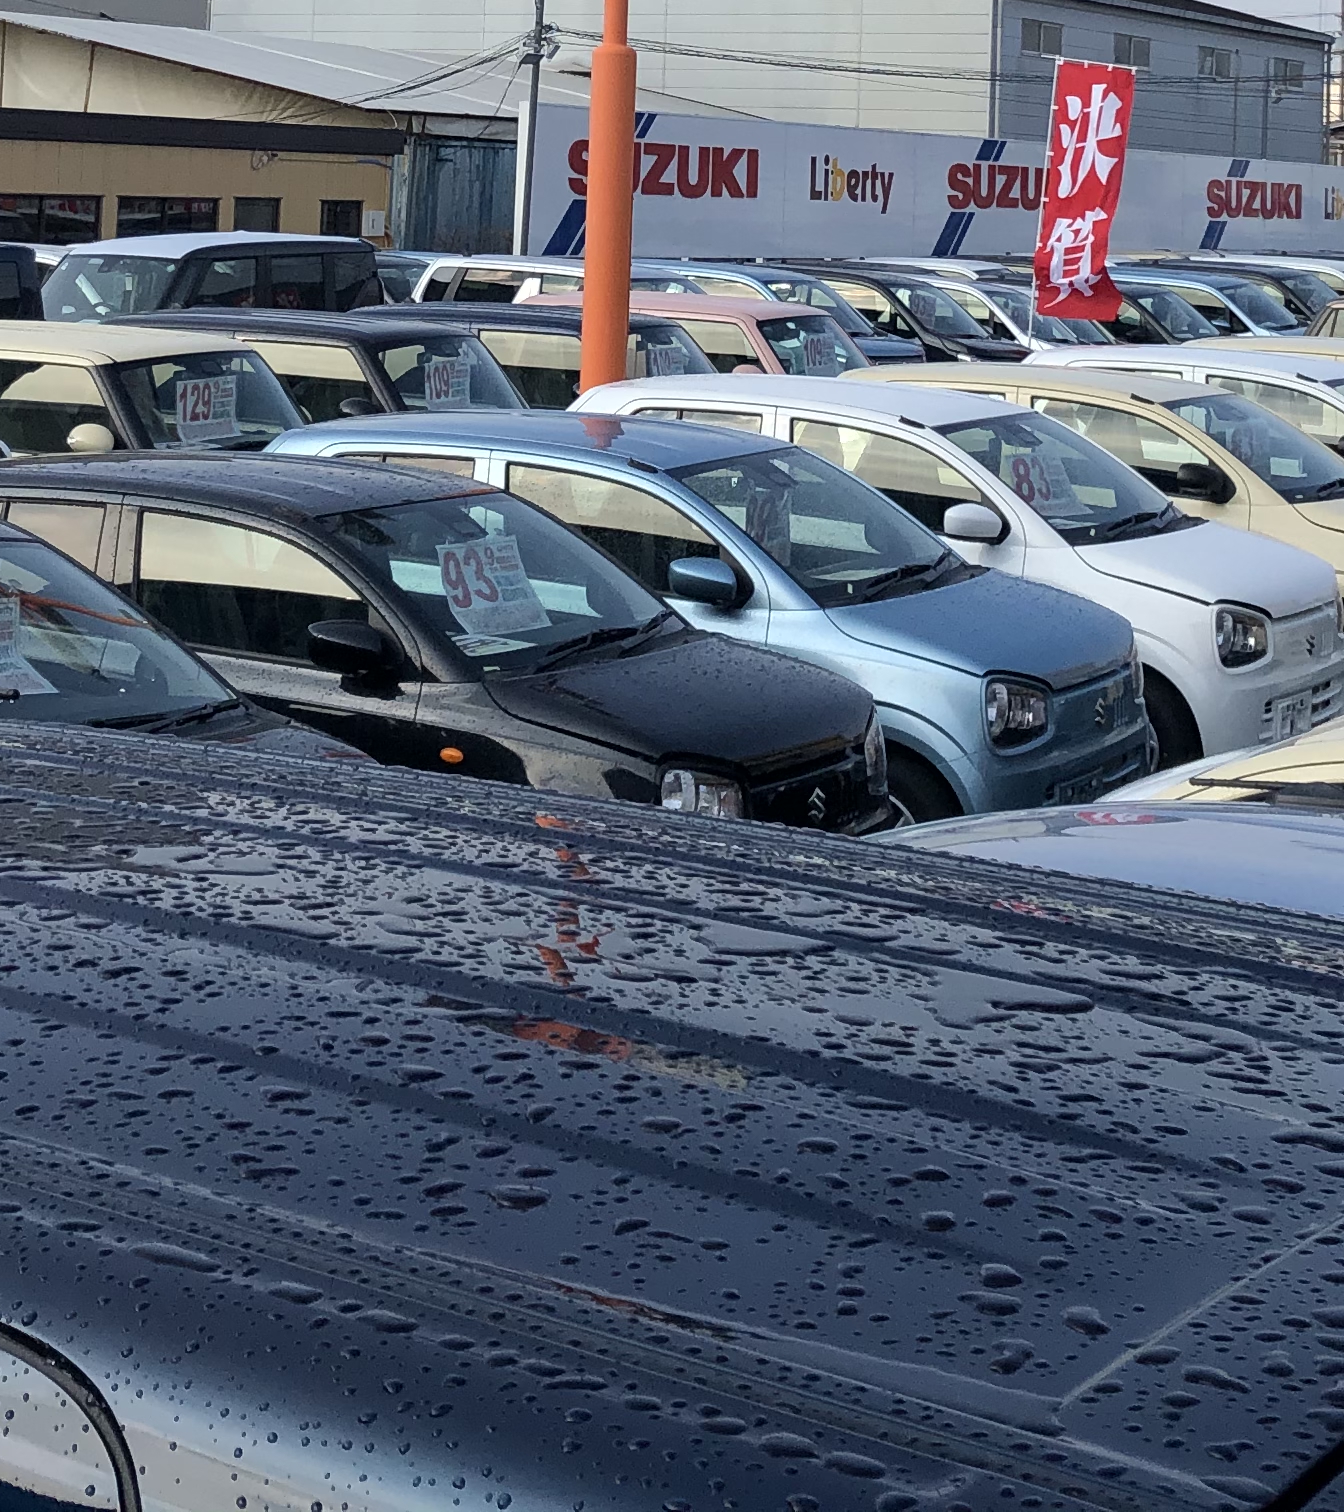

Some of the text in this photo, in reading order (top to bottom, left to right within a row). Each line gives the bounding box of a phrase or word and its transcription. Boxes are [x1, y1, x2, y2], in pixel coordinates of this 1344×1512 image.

[567, 139, 760, 200] SZUKI
[809, 153, 895, 215] Liberty
[1207, 179, 1303, 220] SUZUKI
[1043, 83, 1124, 309] 決算
